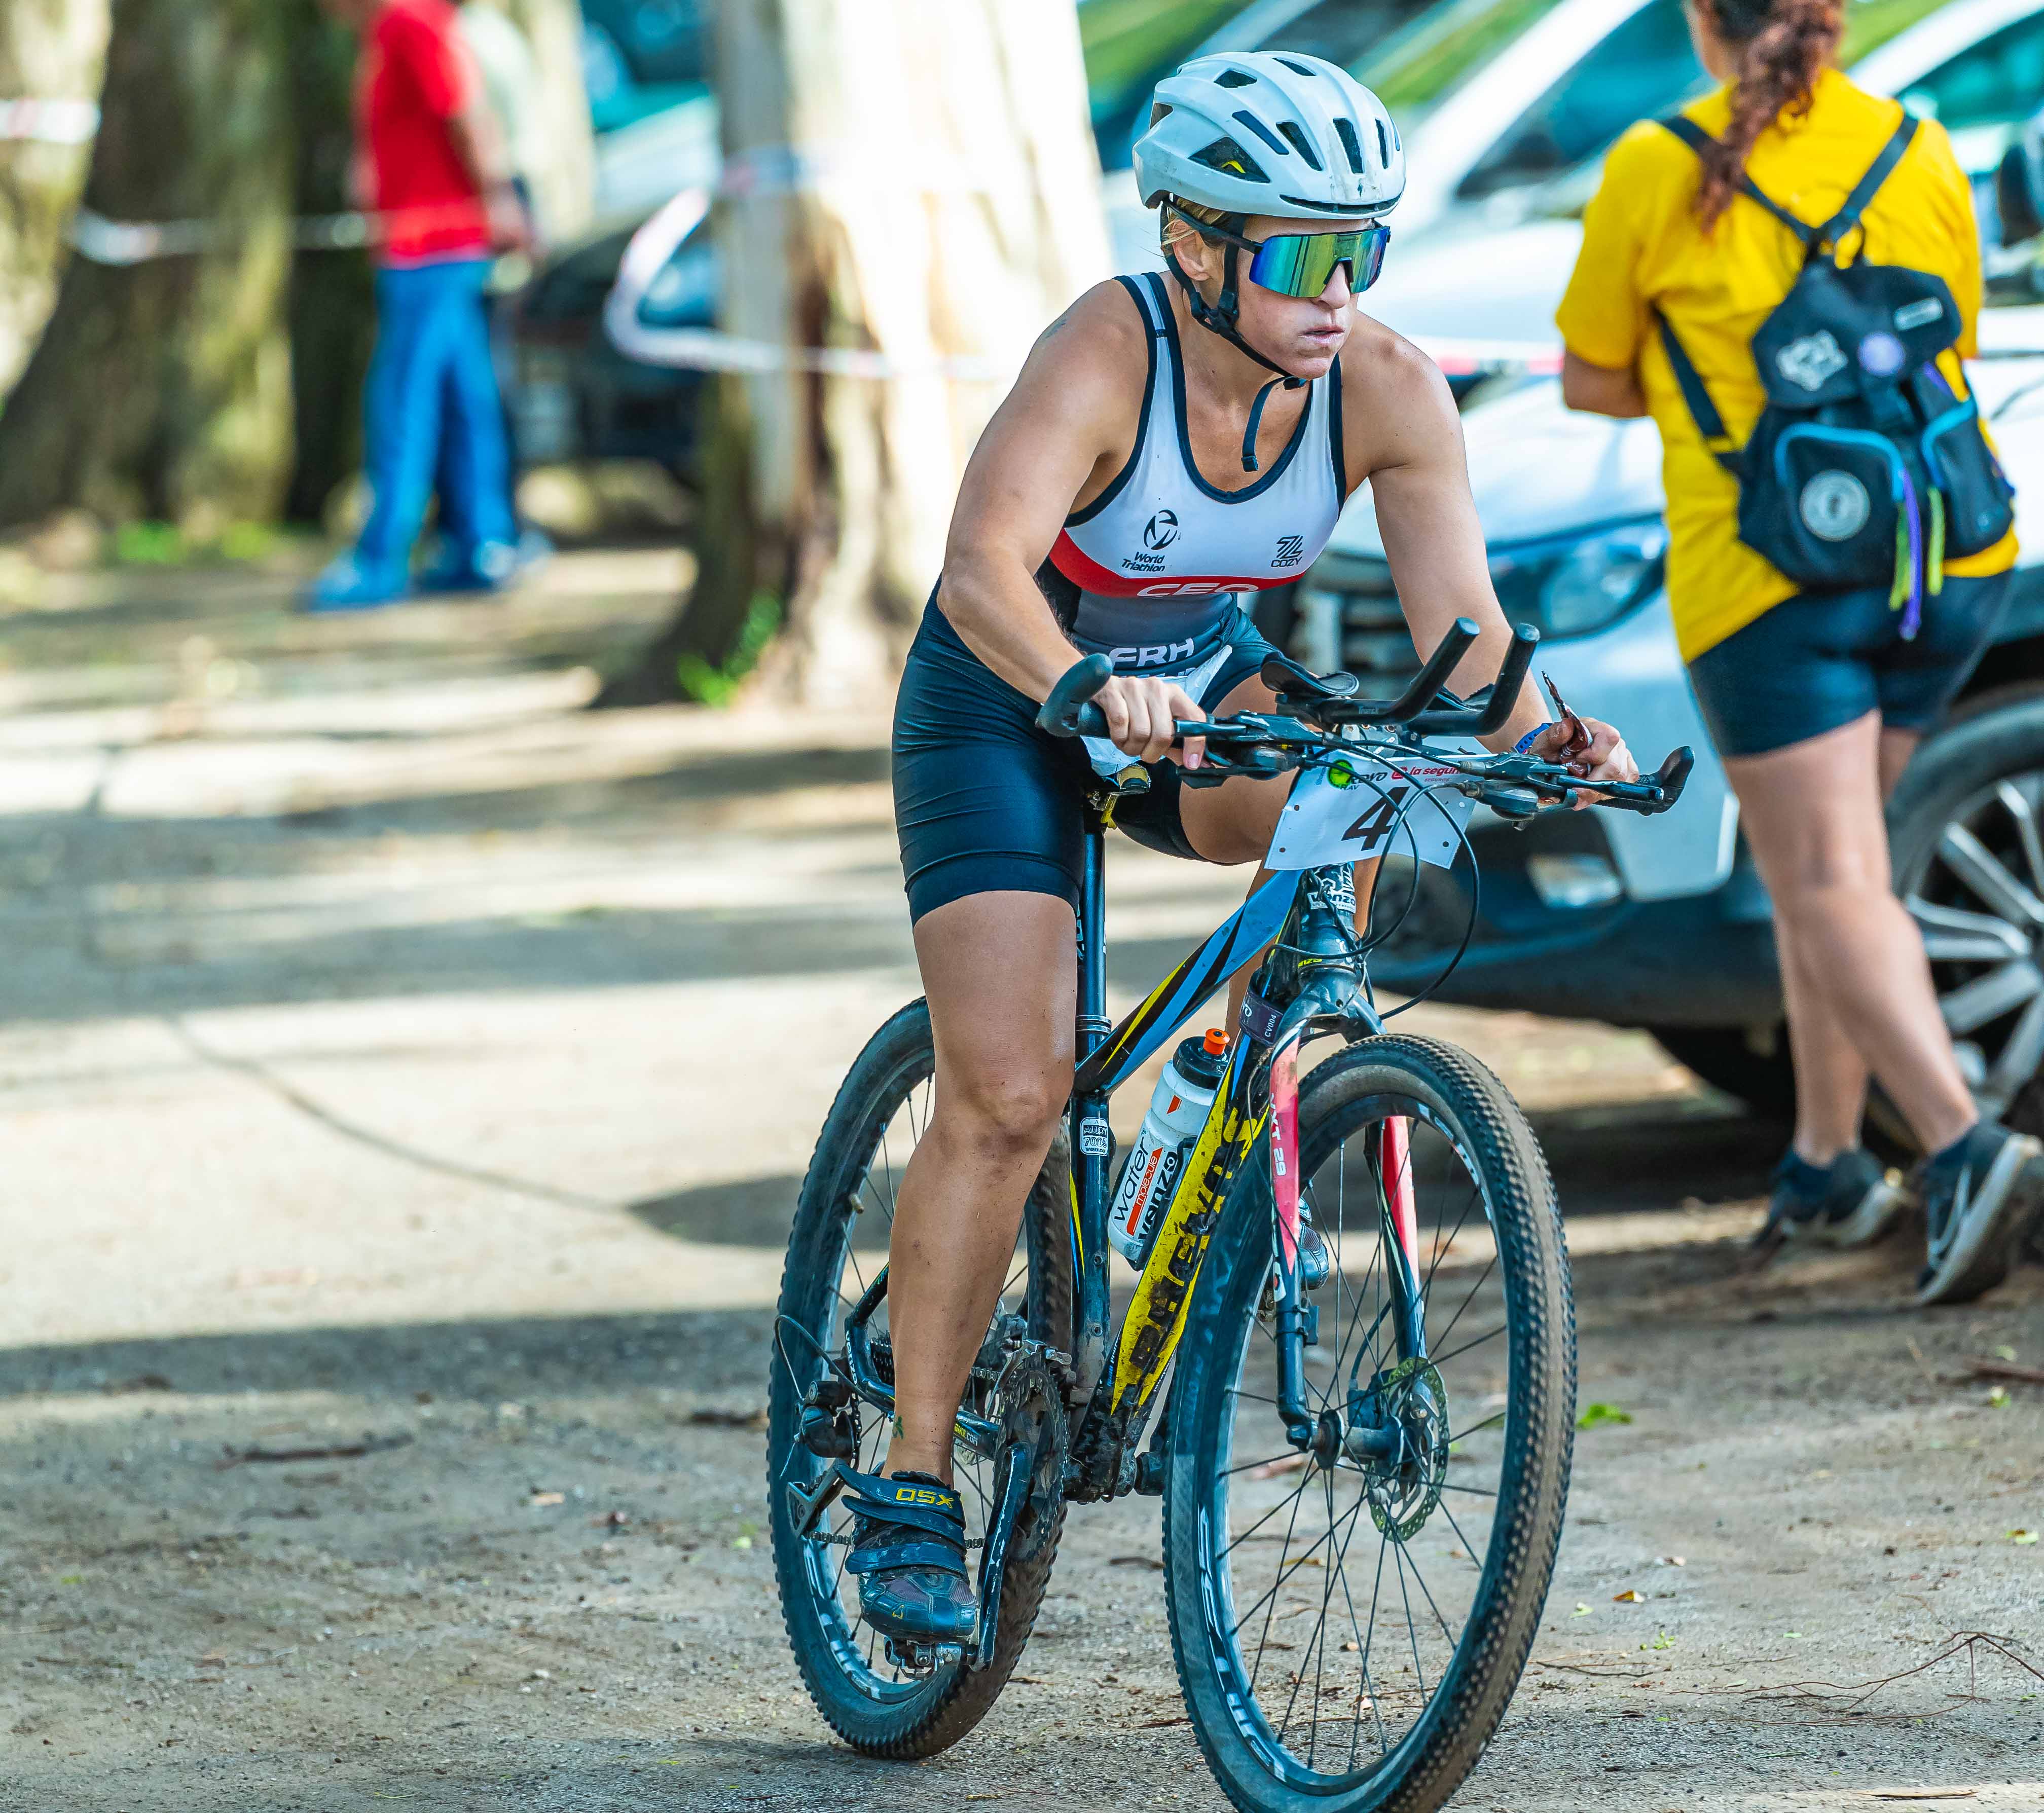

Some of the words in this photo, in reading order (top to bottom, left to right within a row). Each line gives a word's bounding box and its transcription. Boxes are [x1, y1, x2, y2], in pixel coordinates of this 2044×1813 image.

[1121, 558, 1165, 572] Triathlon
[1134, 551, 1165, 564] World
[1270, 557, 1302, 568] COZY
[1410, 766, 1422, 775] la
[1341, 786, 1410, 851] 4
[1264, 1014, 1276, 1037] CV004
[1082, 1136, 1107, 1148] 7005
[1273, 1147, 1287, 1176] 29
[1114, 1136, 1148, 1222] water
[1136, 1156, 1157, 1206] molecule
